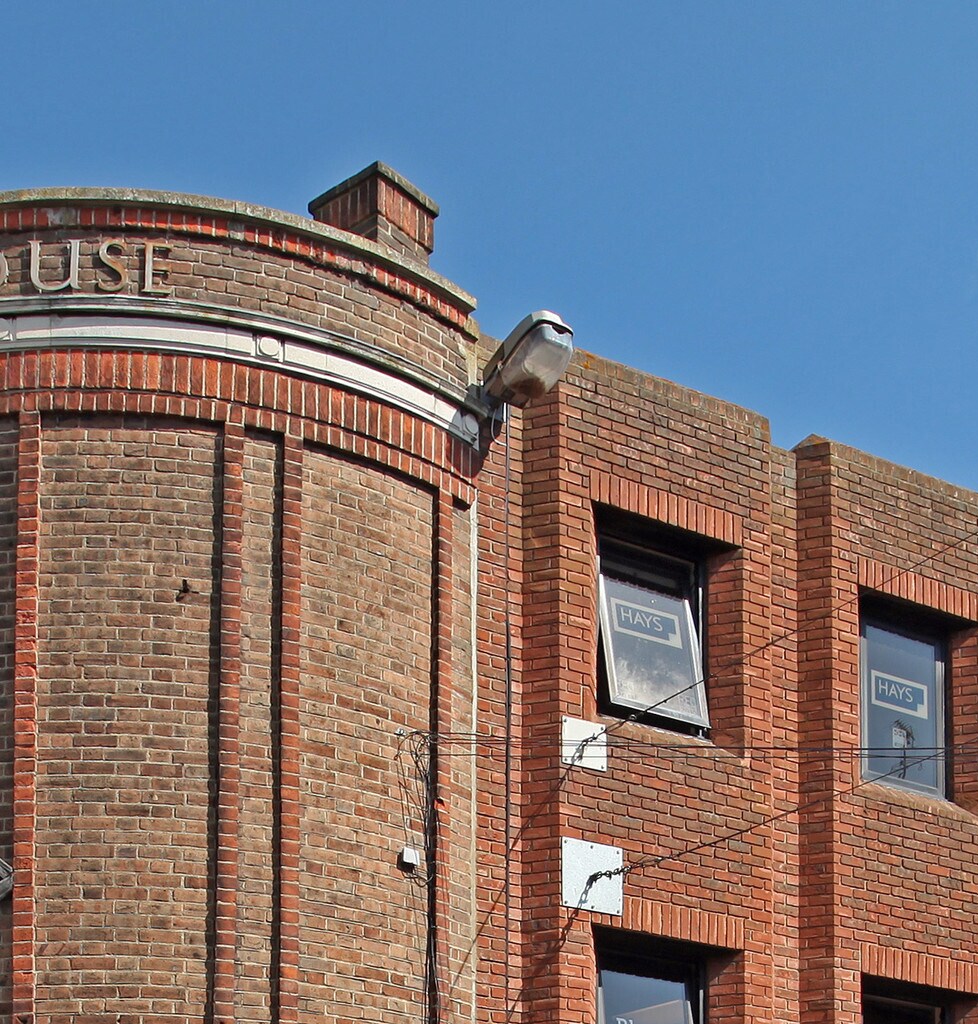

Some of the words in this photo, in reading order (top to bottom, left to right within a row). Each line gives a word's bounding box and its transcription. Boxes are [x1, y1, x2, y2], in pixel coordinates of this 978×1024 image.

[0, 239, 173, 296] USE
[620, 606, 663, 632] HAYS
[878, 679, 913, 703] HAYS
